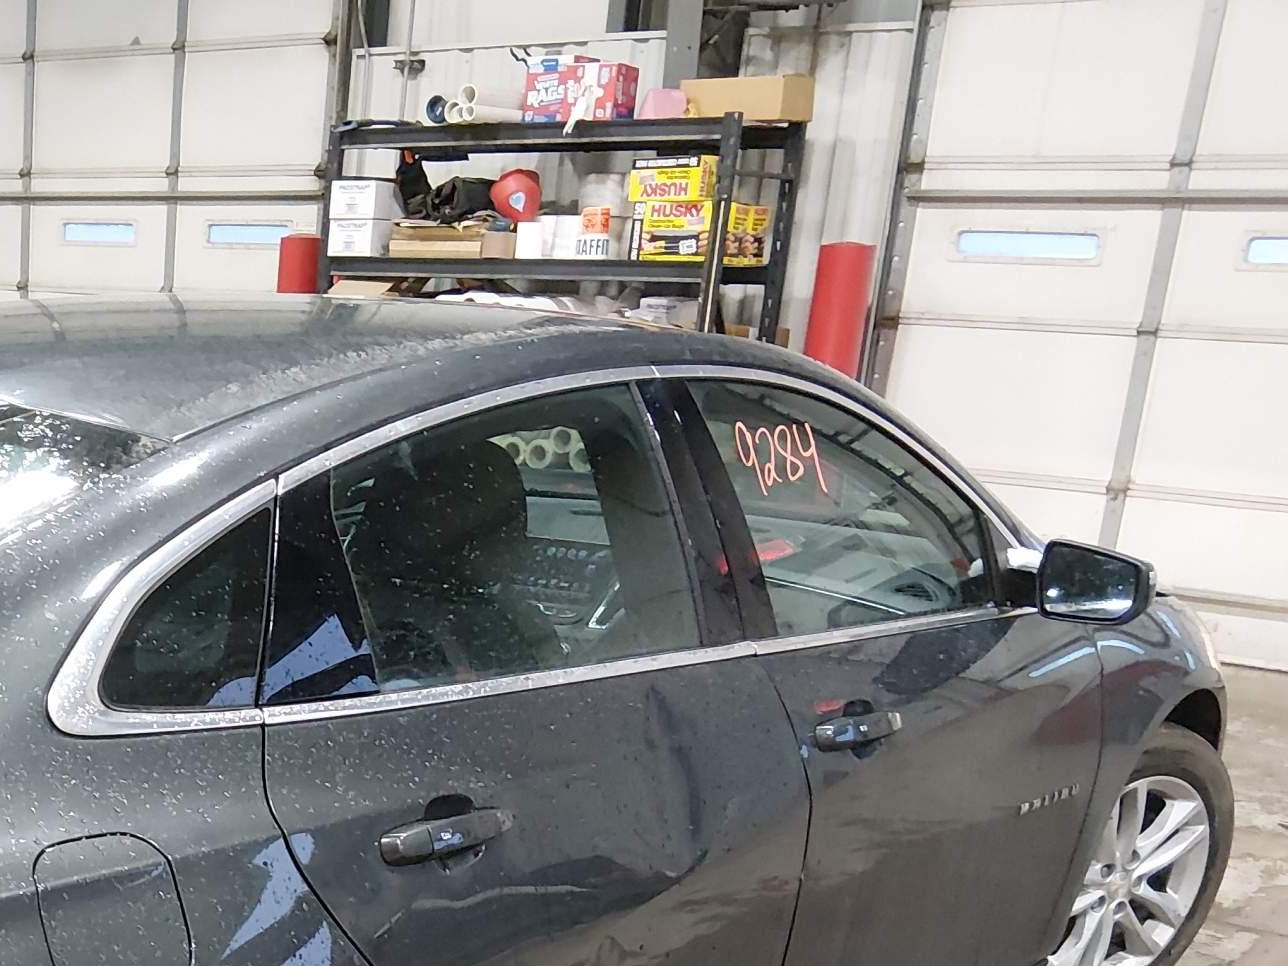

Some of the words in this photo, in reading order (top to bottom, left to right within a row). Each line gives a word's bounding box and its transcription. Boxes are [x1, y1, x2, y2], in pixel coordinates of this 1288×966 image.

[527, 85, 566, 107] RAGS
[641, 182, 689, 198] HUSKY
[650, 204, 704, 218] HUSKY
[735, 421, 828, 496] 9284
